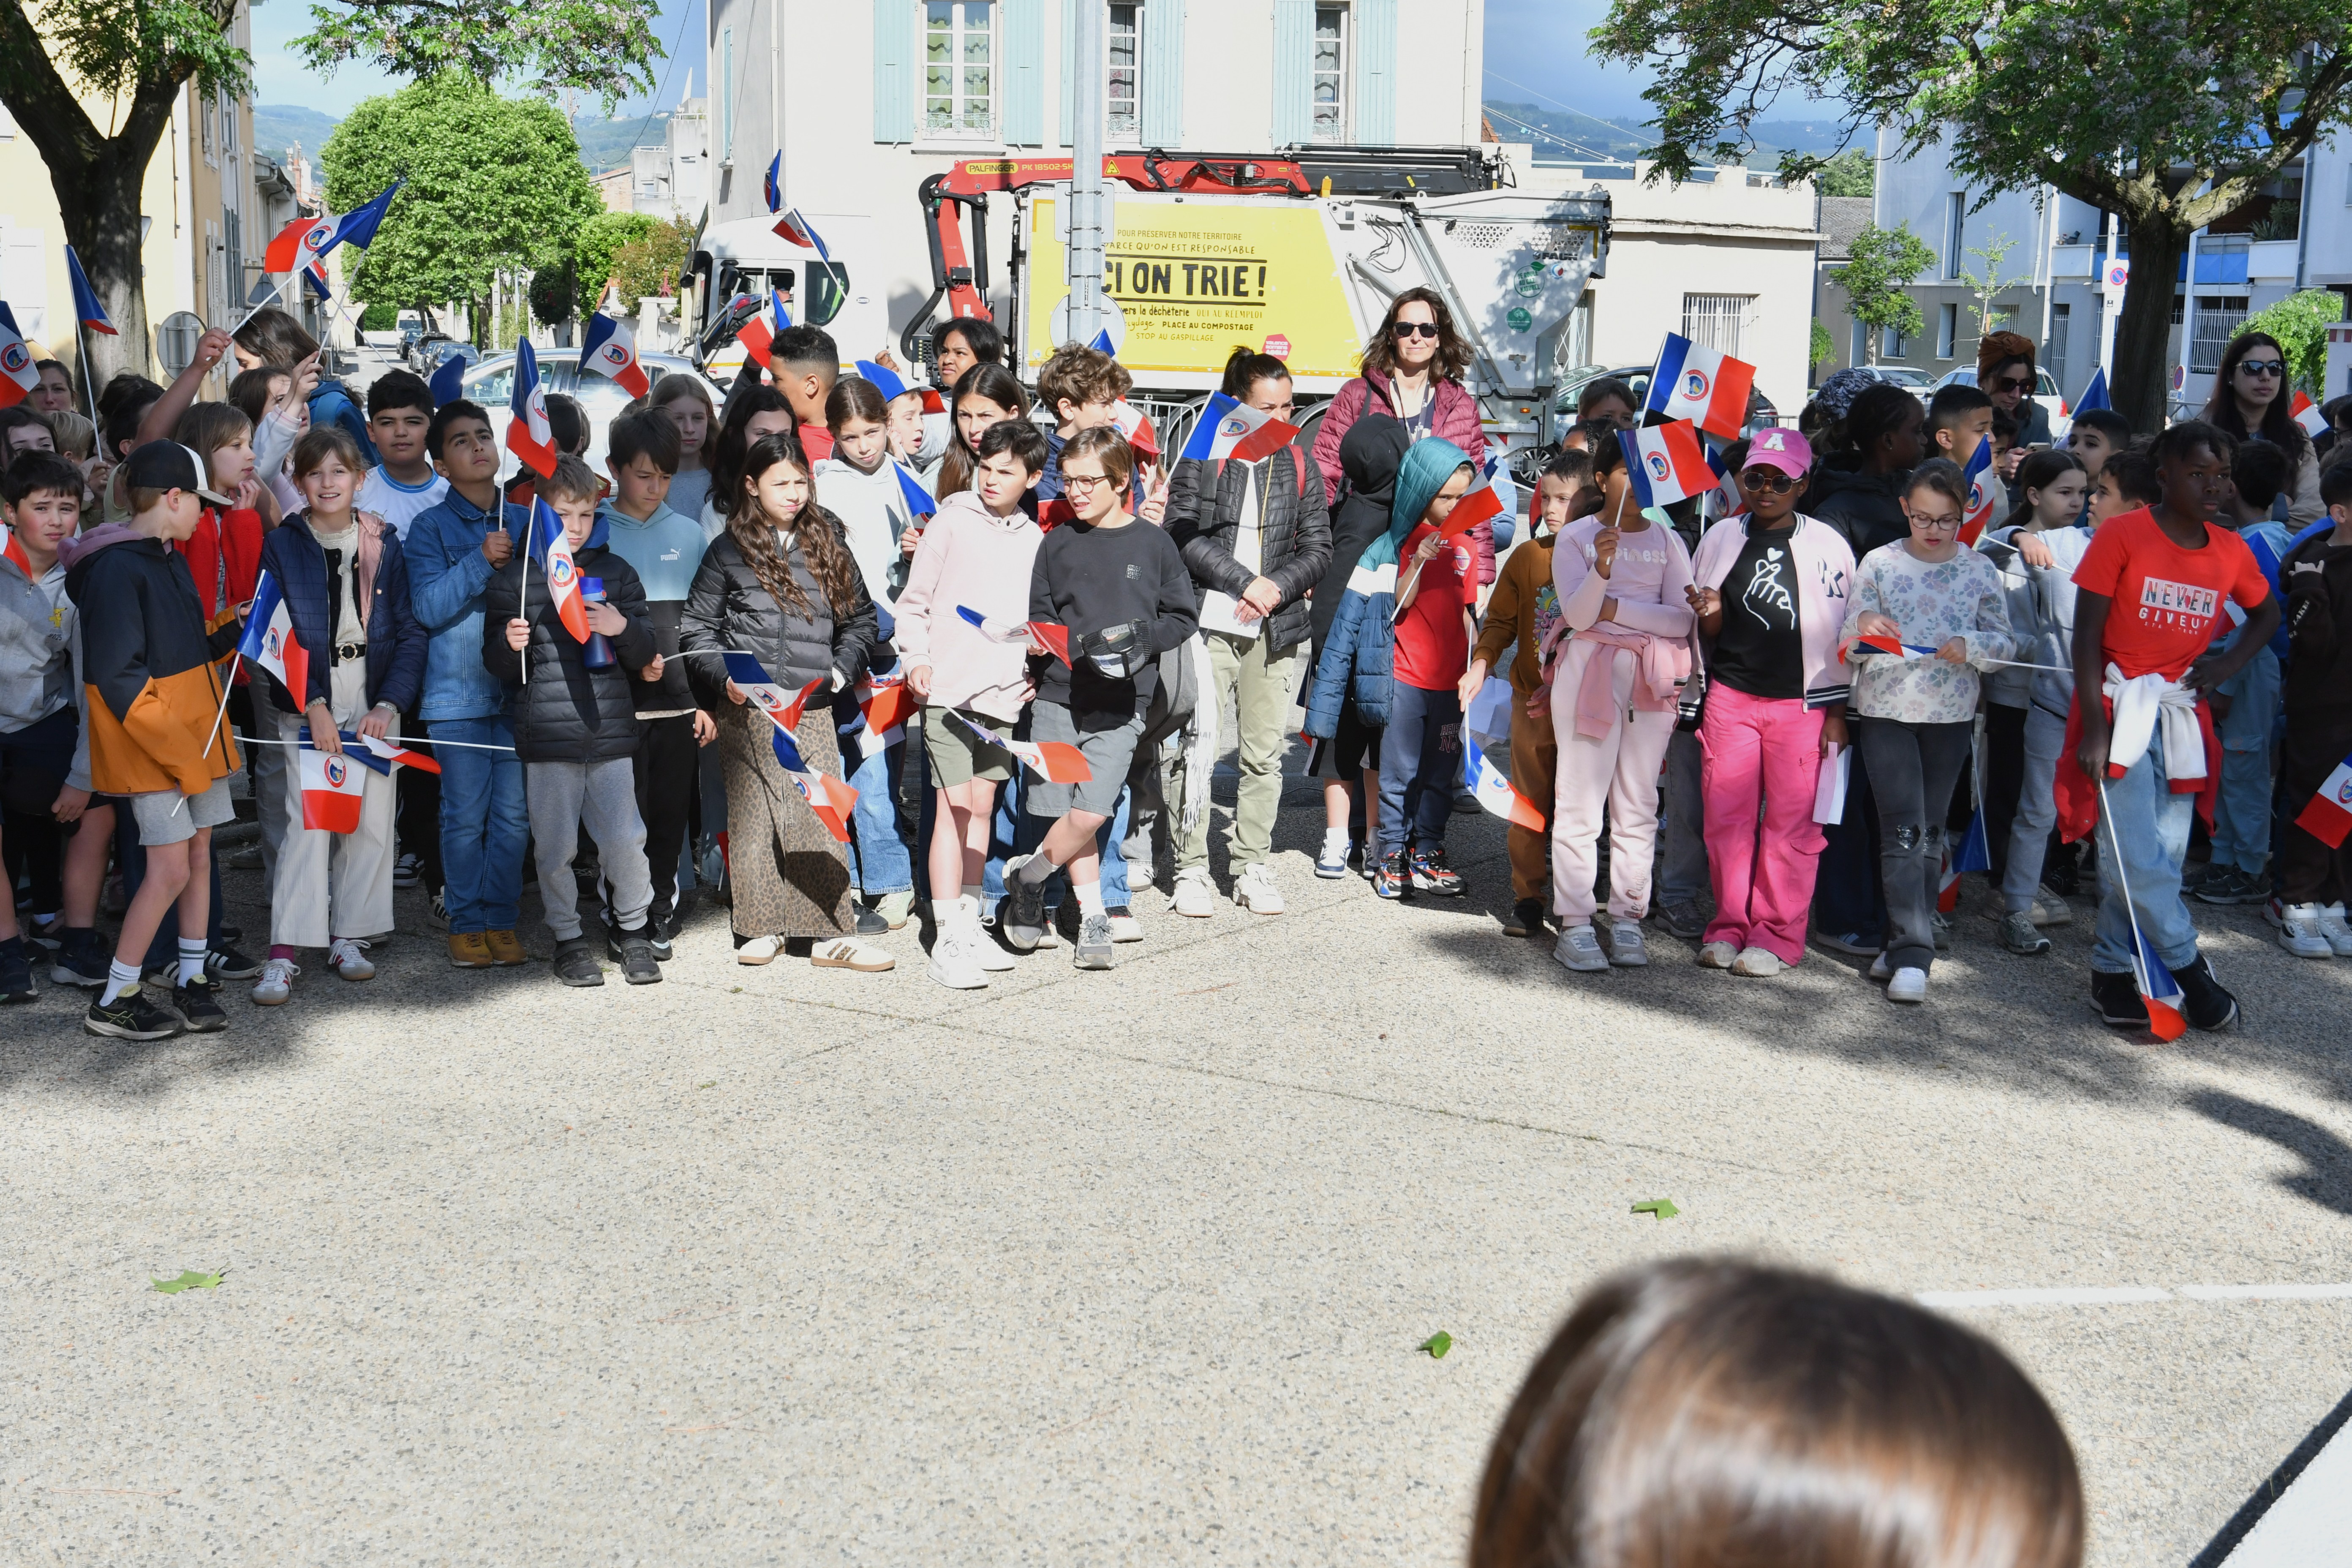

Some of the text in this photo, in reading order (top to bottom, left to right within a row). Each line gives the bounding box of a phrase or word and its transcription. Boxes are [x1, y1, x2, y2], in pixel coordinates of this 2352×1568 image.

[969, 164, 1015, 172] PALFINGER
[1138, 229, 1177, 238] PRÉSERVER
[1203, 232, 1242, 240] TERRITOIRE
[1136, 242, 1168, 251] QU'ON
[1172, 244, 1187, 252] EST
[1191, 244, 1255, 254] RESPONSABLE
[1542, 252, 1578, 261] FAUN
[1132, 262, 1171, 294] ON
[1182, 263, 1250, 297] TRIE
[1523, 270, 1539, 279] ROULE
[1520, 284, 1541, 293] NATUREL
[1140, 304, 1146, 315] la
[1149, 305, 1190, 316] déchèterie
[1197, 309, 1209, 317] OUI
[1225, 308, 1262, 318] RÉEMPLOI
[1201, 322, 1254, 331] COMPOSTAGE
[1171, 333, 1214, 341] GASPILLAGE
[1762, 433, 1786, 452] A
[2145, 580, 2213, 614] NEVER
